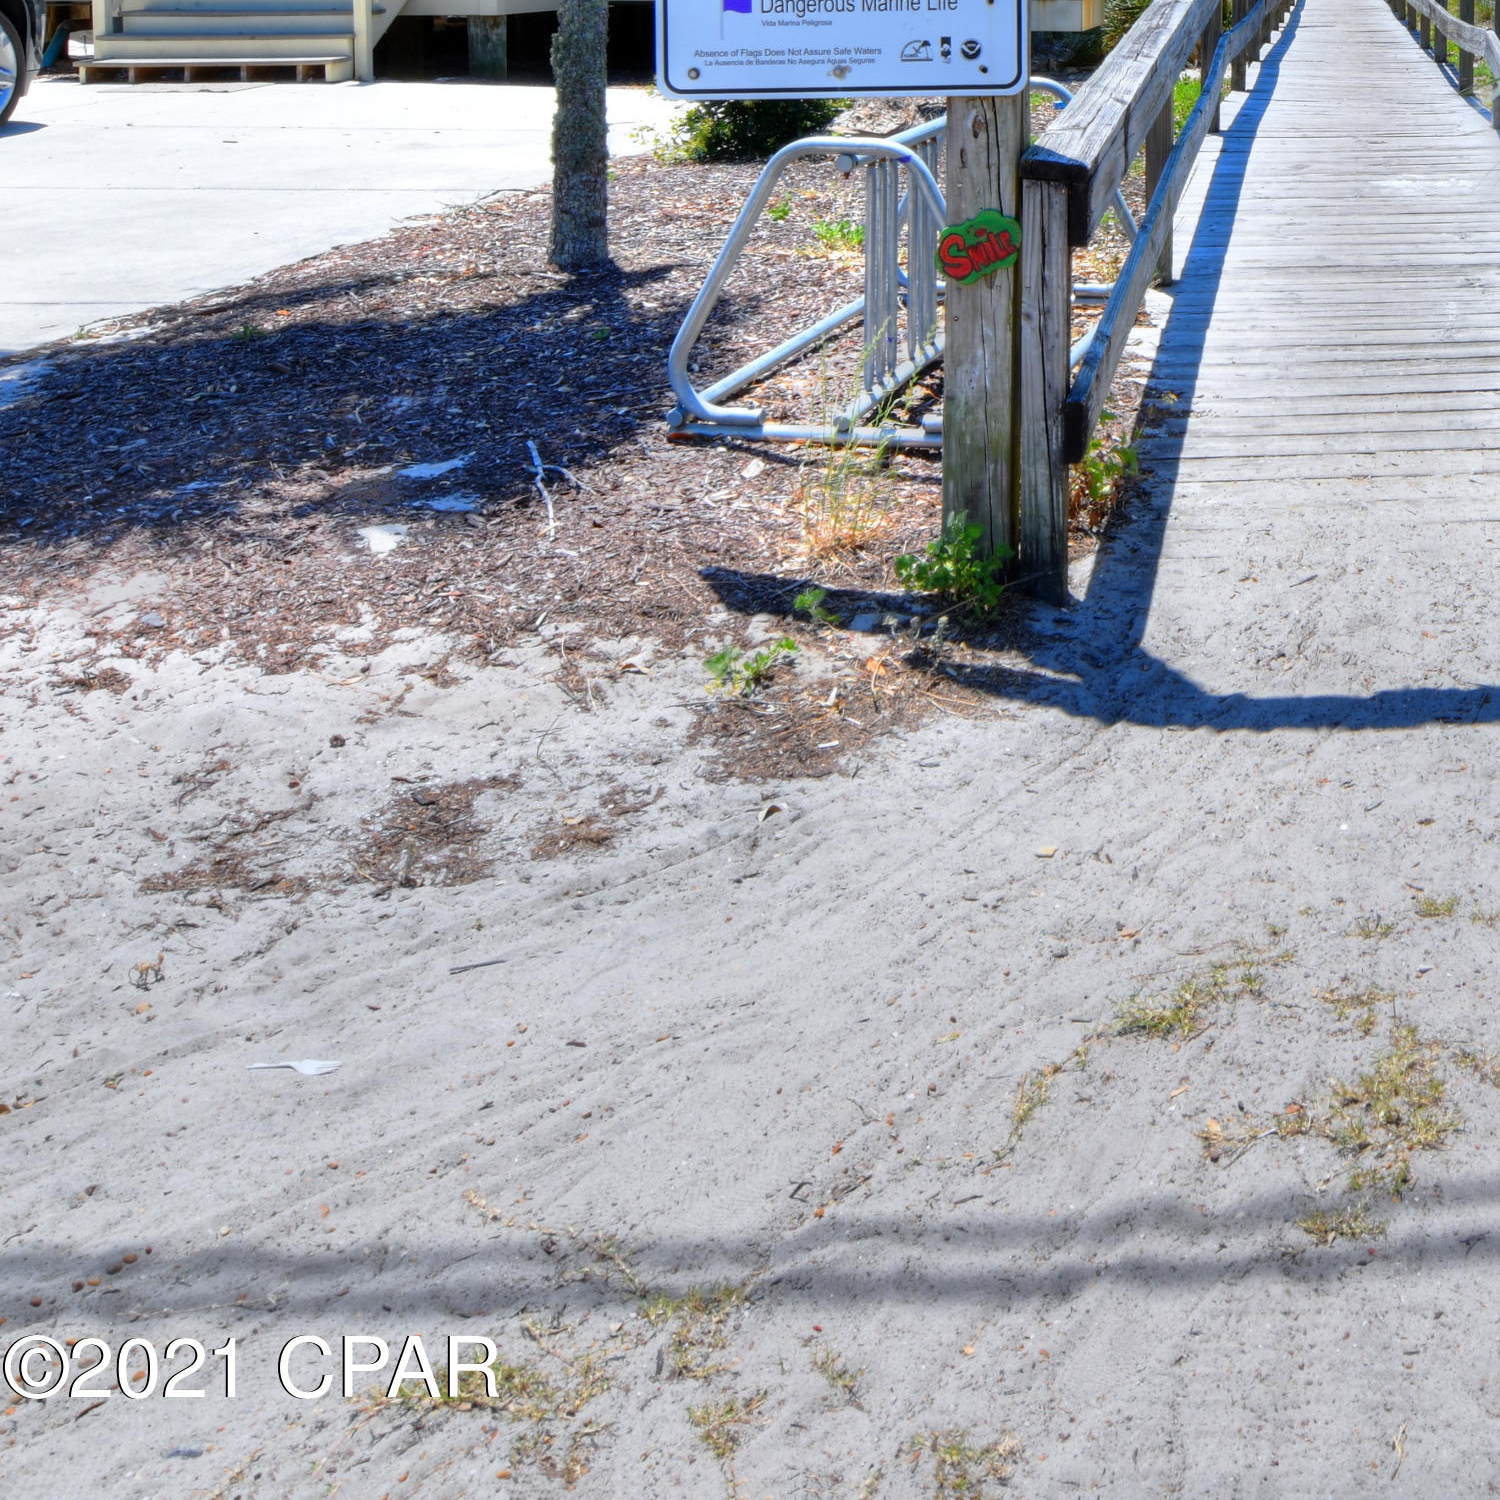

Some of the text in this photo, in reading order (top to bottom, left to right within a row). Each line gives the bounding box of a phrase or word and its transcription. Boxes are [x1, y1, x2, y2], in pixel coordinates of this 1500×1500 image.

[694, 45, 881, 60] Absence of Flags Does Not Assure Safe Waters
